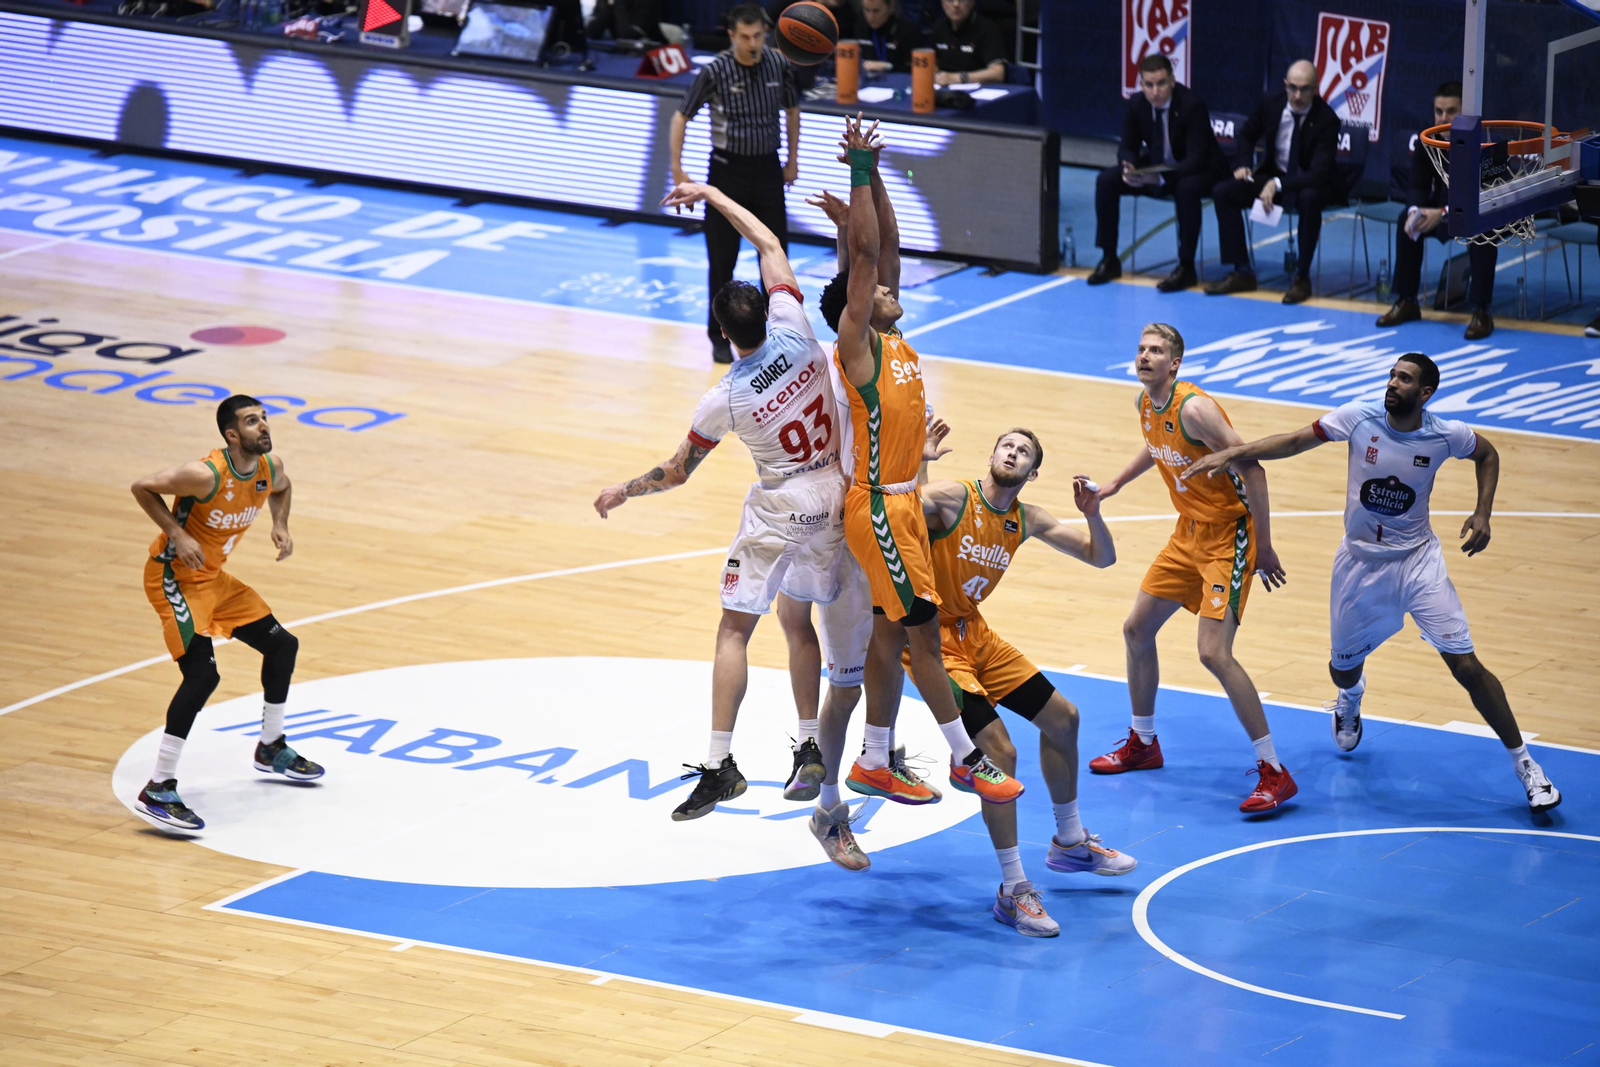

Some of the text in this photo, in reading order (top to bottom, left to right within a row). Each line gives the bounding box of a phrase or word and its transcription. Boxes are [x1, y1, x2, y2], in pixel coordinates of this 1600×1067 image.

[0, 191, 450, 280] POSTELA
[370, 210, 567, 252] DE
[750, 353, 793, 395] SUÁREZ
[766, 361, 817, 412] cenor
[778, 393, 832, 463] 93
[1368, 493, 1404, 510] Galicia
[1369, 483, 1409, 501] Estrella
[788, 513, 796, 522] A
[1377, 524, 1383, 543] 1
[222, 534, 238, 555] 4
[959, 534, 1011, 566] Sevilla
[285, 716, 888, 835] ABANCA
